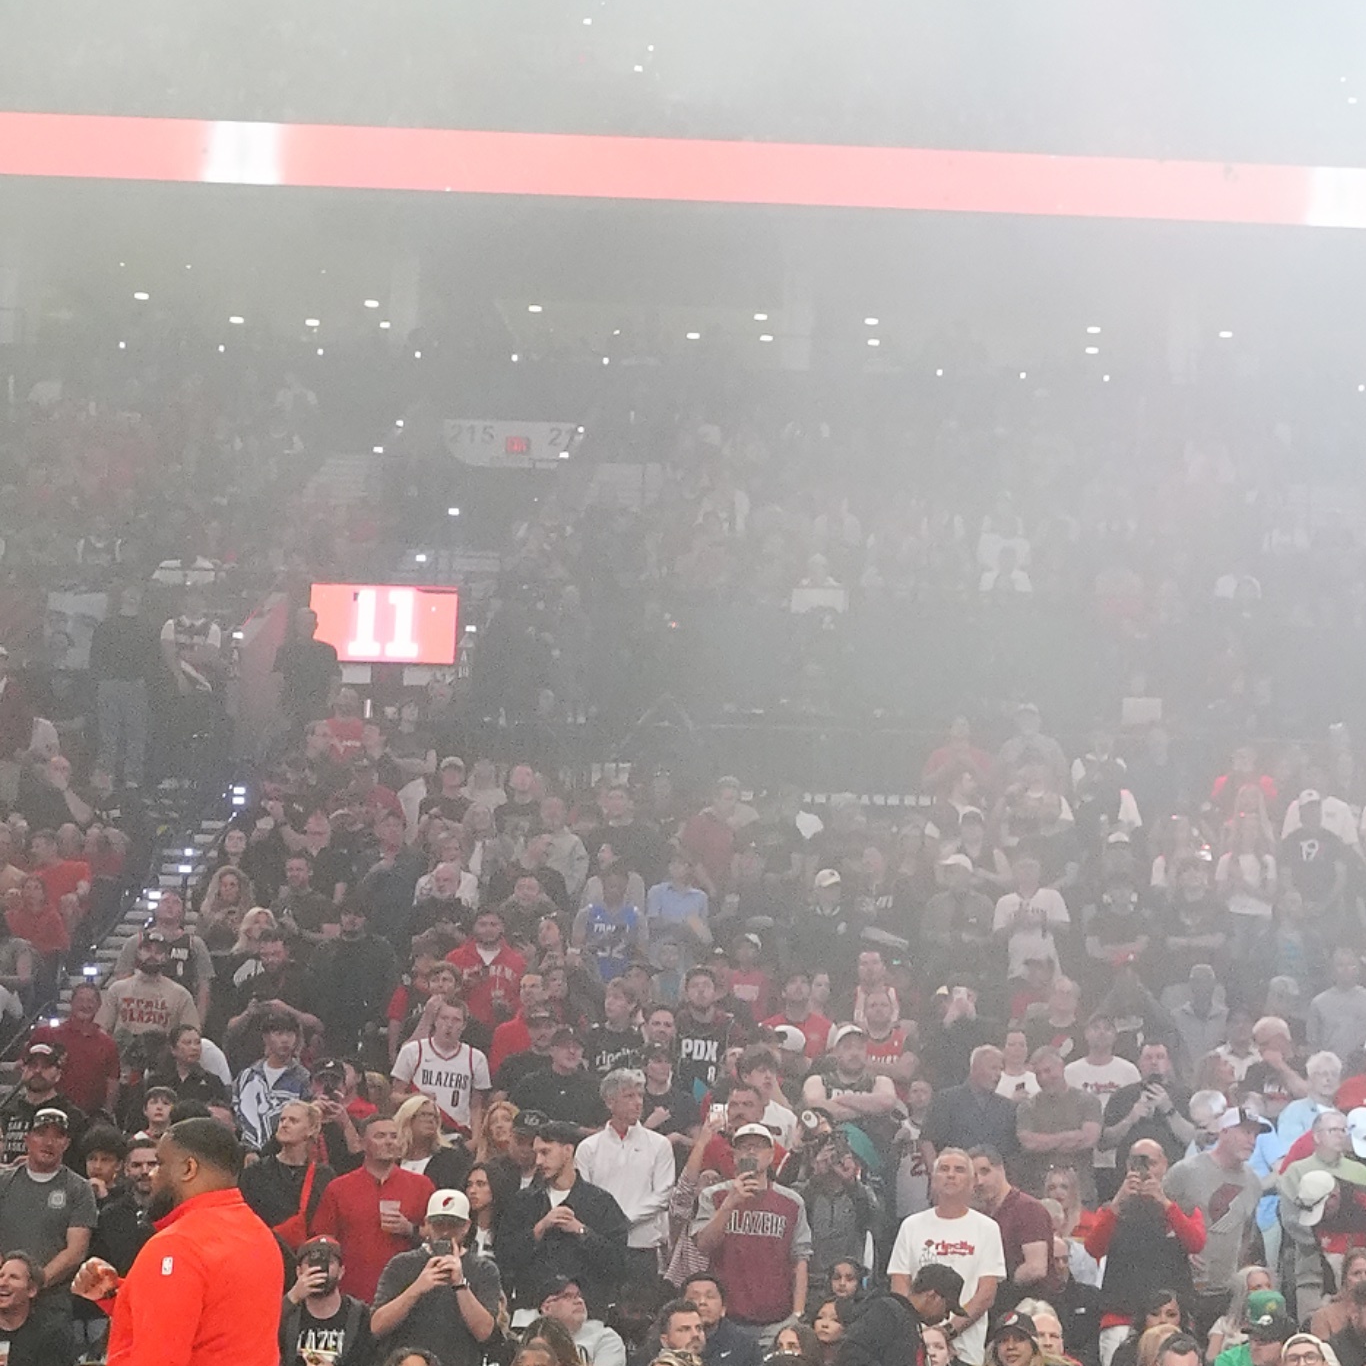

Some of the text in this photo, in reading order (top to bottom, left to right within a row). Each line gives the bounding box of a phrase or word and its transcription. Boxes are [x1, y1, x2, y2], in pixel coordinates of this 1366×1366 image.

[347, 589, 419, 658] 11
[681, 1038, 719, 1062] PDX
[422, 1069, 469, 1090] BLAZERS
[450, 1089, 460, 1108] 0
